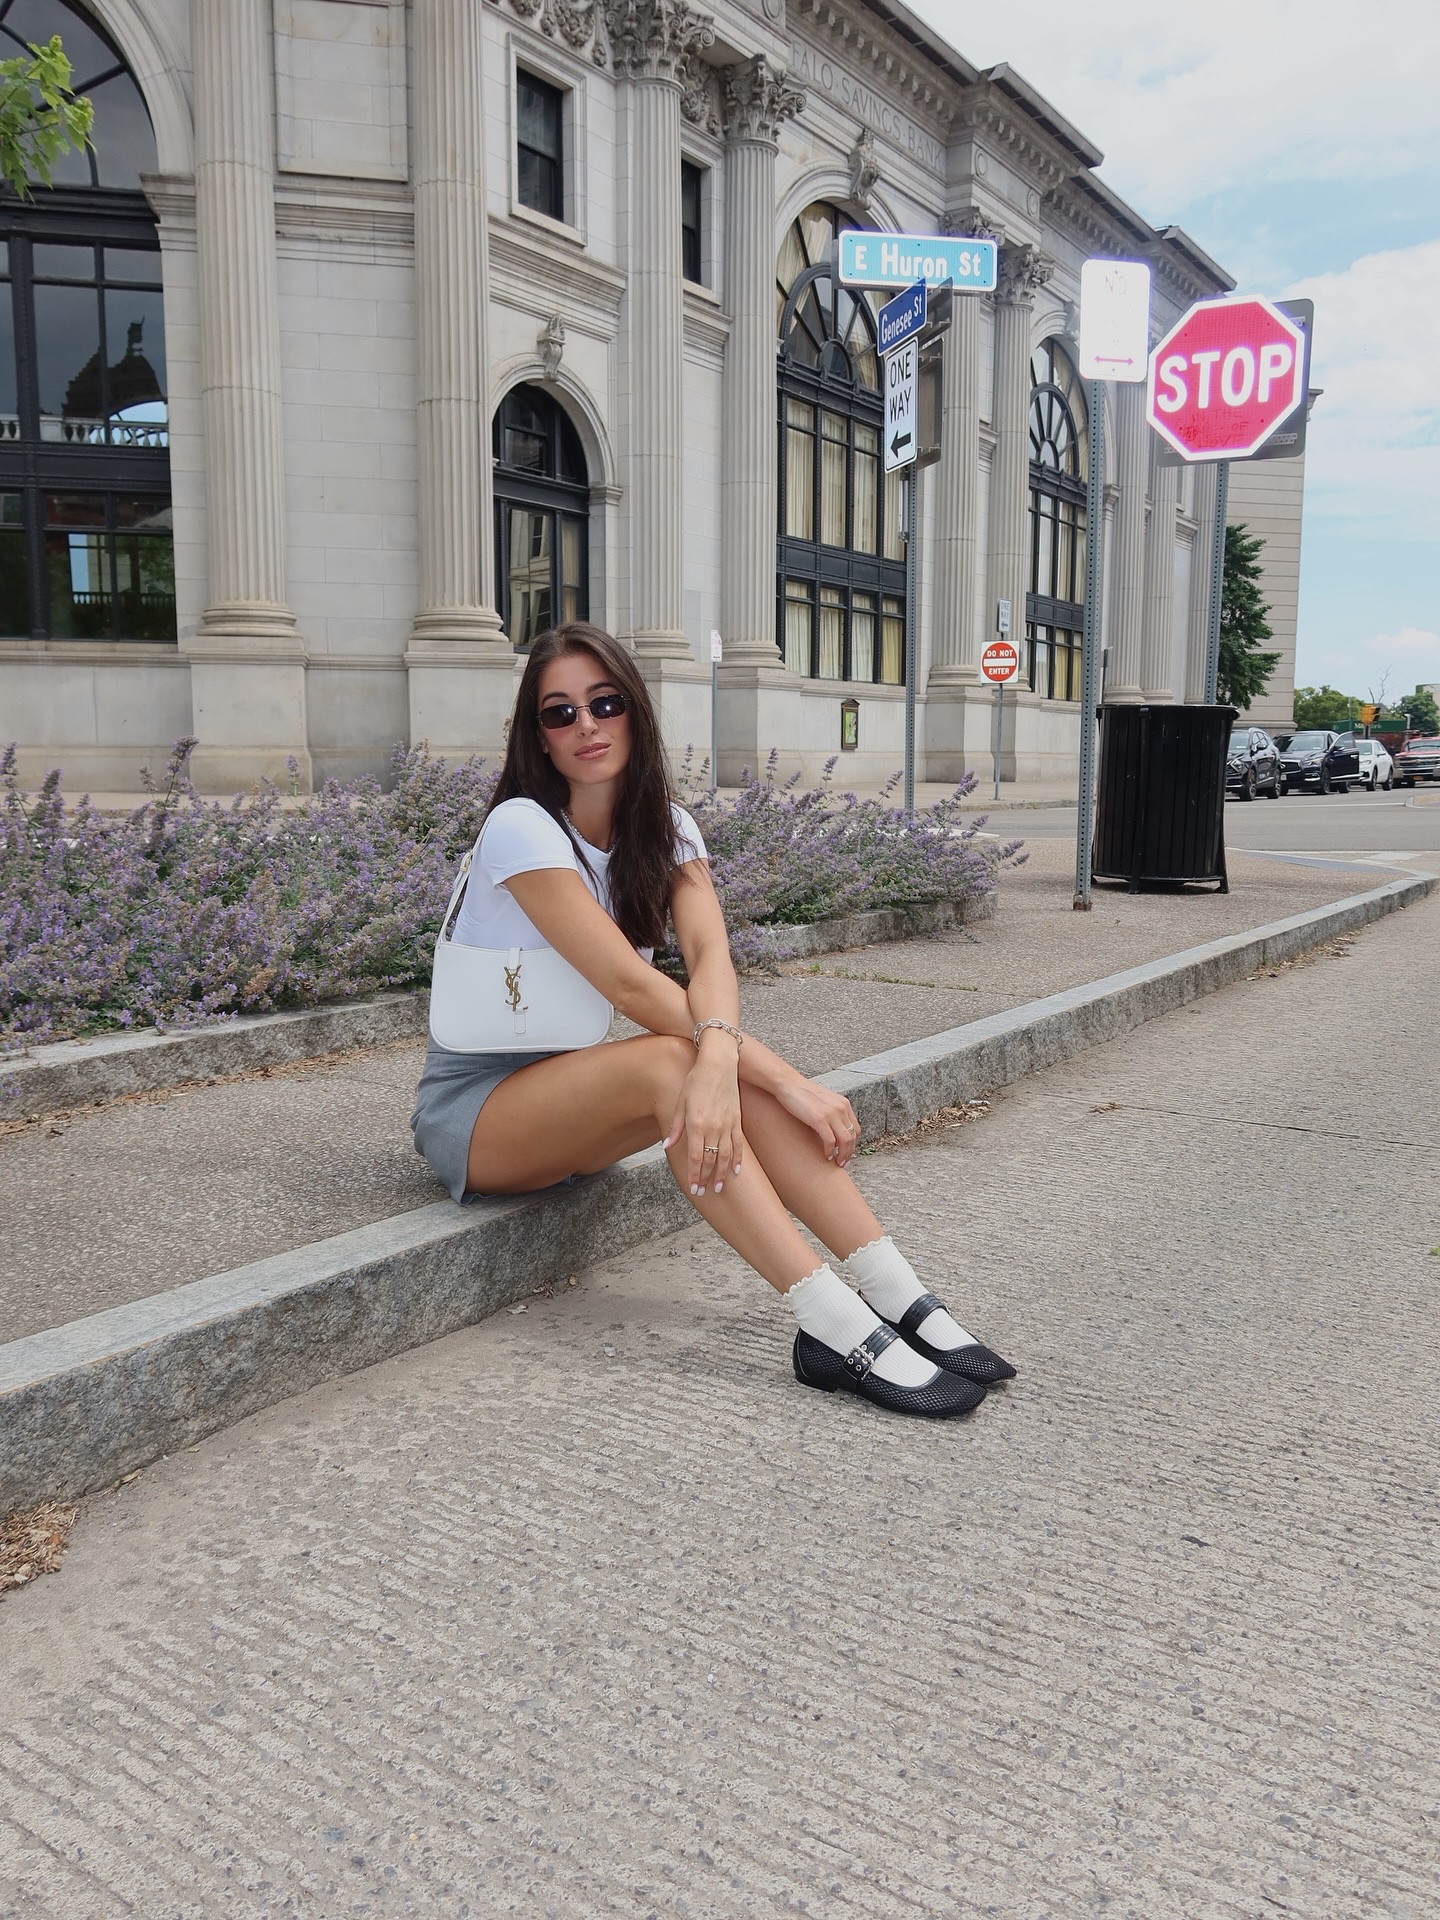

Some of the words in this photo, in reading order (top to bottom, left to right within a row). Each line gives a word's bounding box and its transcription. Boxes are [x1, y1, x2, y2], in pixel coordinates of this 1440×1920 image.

[908, 125, 943, 174] BANK
[855, 245, 867, 270] E
[881, 242, 947, 279] Huron
[959, 252, 981, 277] St
[881, 308, 912, 345] Genesee
[913, 295, 923, 316] St
[890, 351, 912, 388] ONE
[1157, 343, 1292, 413] STOP
[889, 386, 912, 424] WAY
[988, 667, 1010, 675] ENTER
[1000, 649, 1013, 657] NOT
